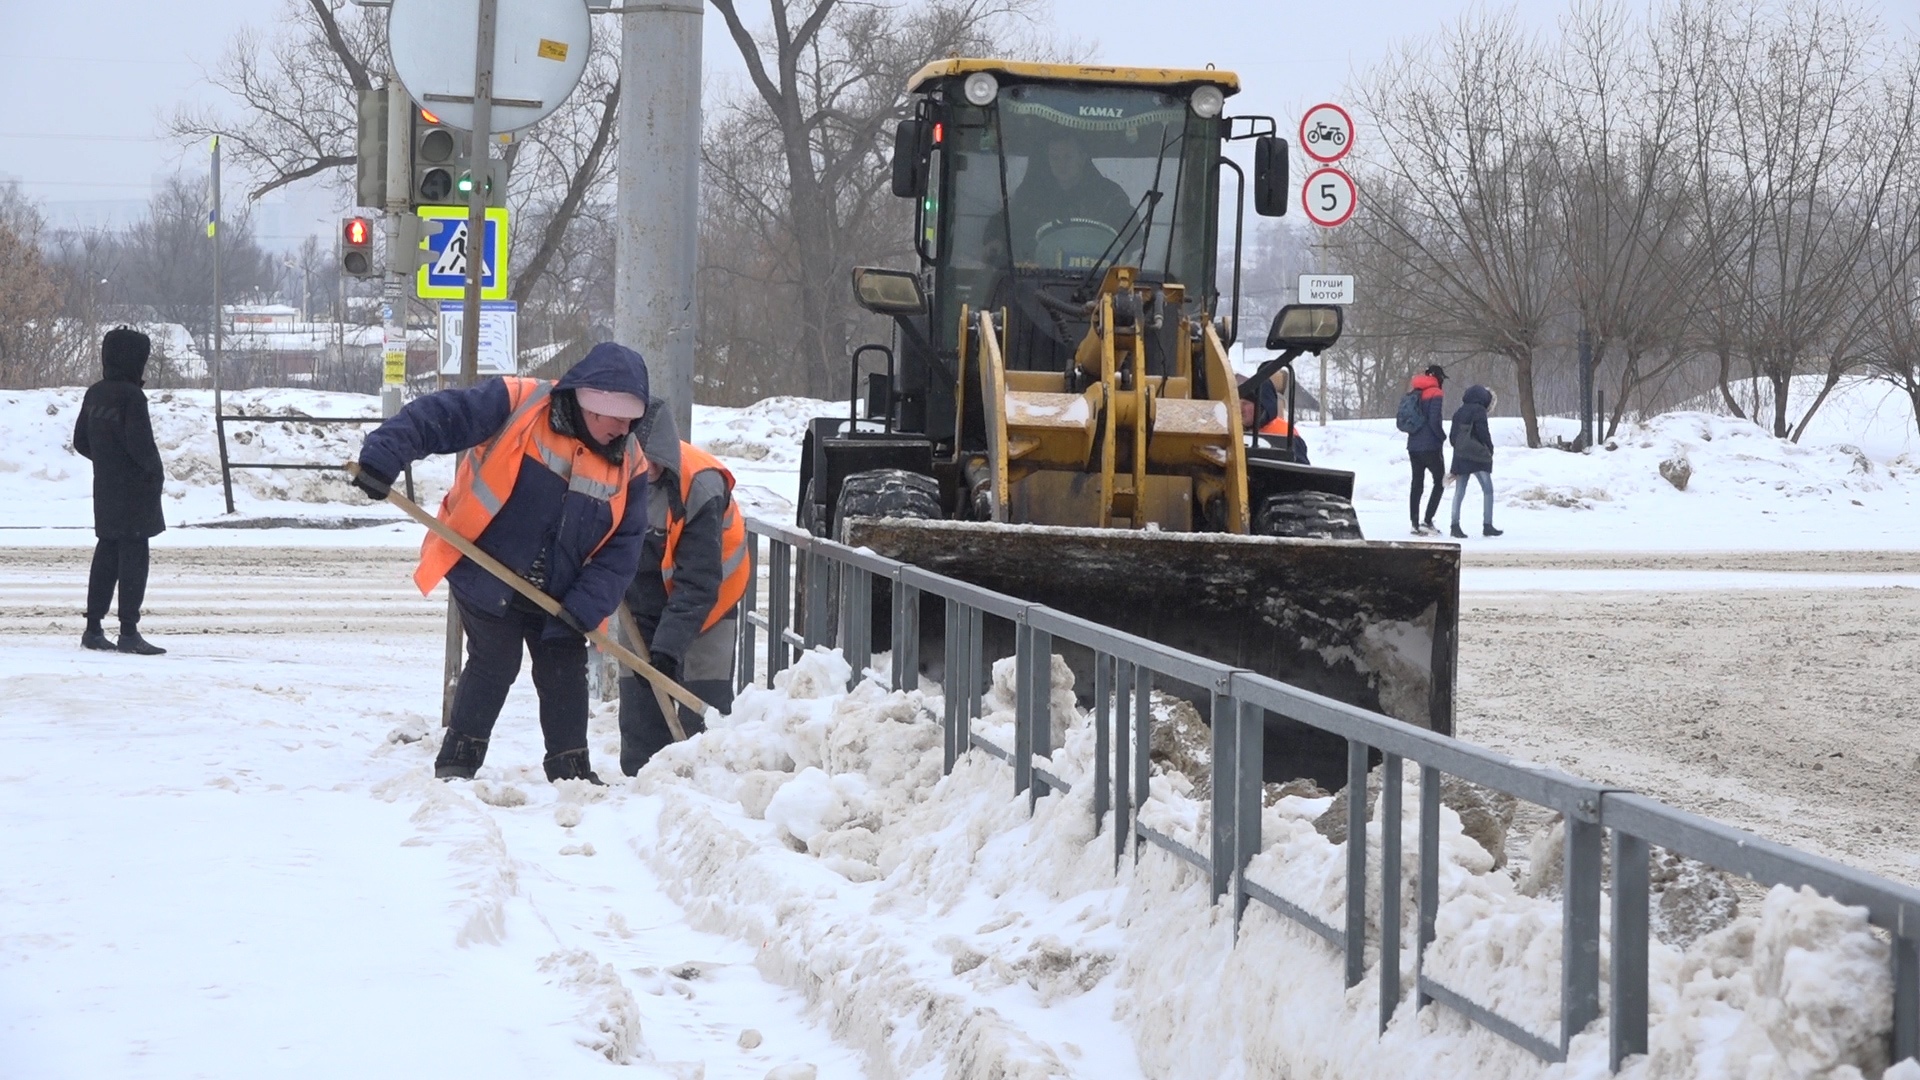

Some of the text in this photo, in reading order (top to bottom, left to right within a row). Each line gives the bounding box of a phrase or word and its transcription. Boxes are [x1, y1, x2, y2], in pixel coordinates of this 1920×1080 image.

[1079, 105, 1123, 118] KAMAZ
[1320, 184, 1337, 211] 5
[1310, 279, 1343, 288] ГЛУШИ
[1310, 291, 1344, 300] МОТОР
